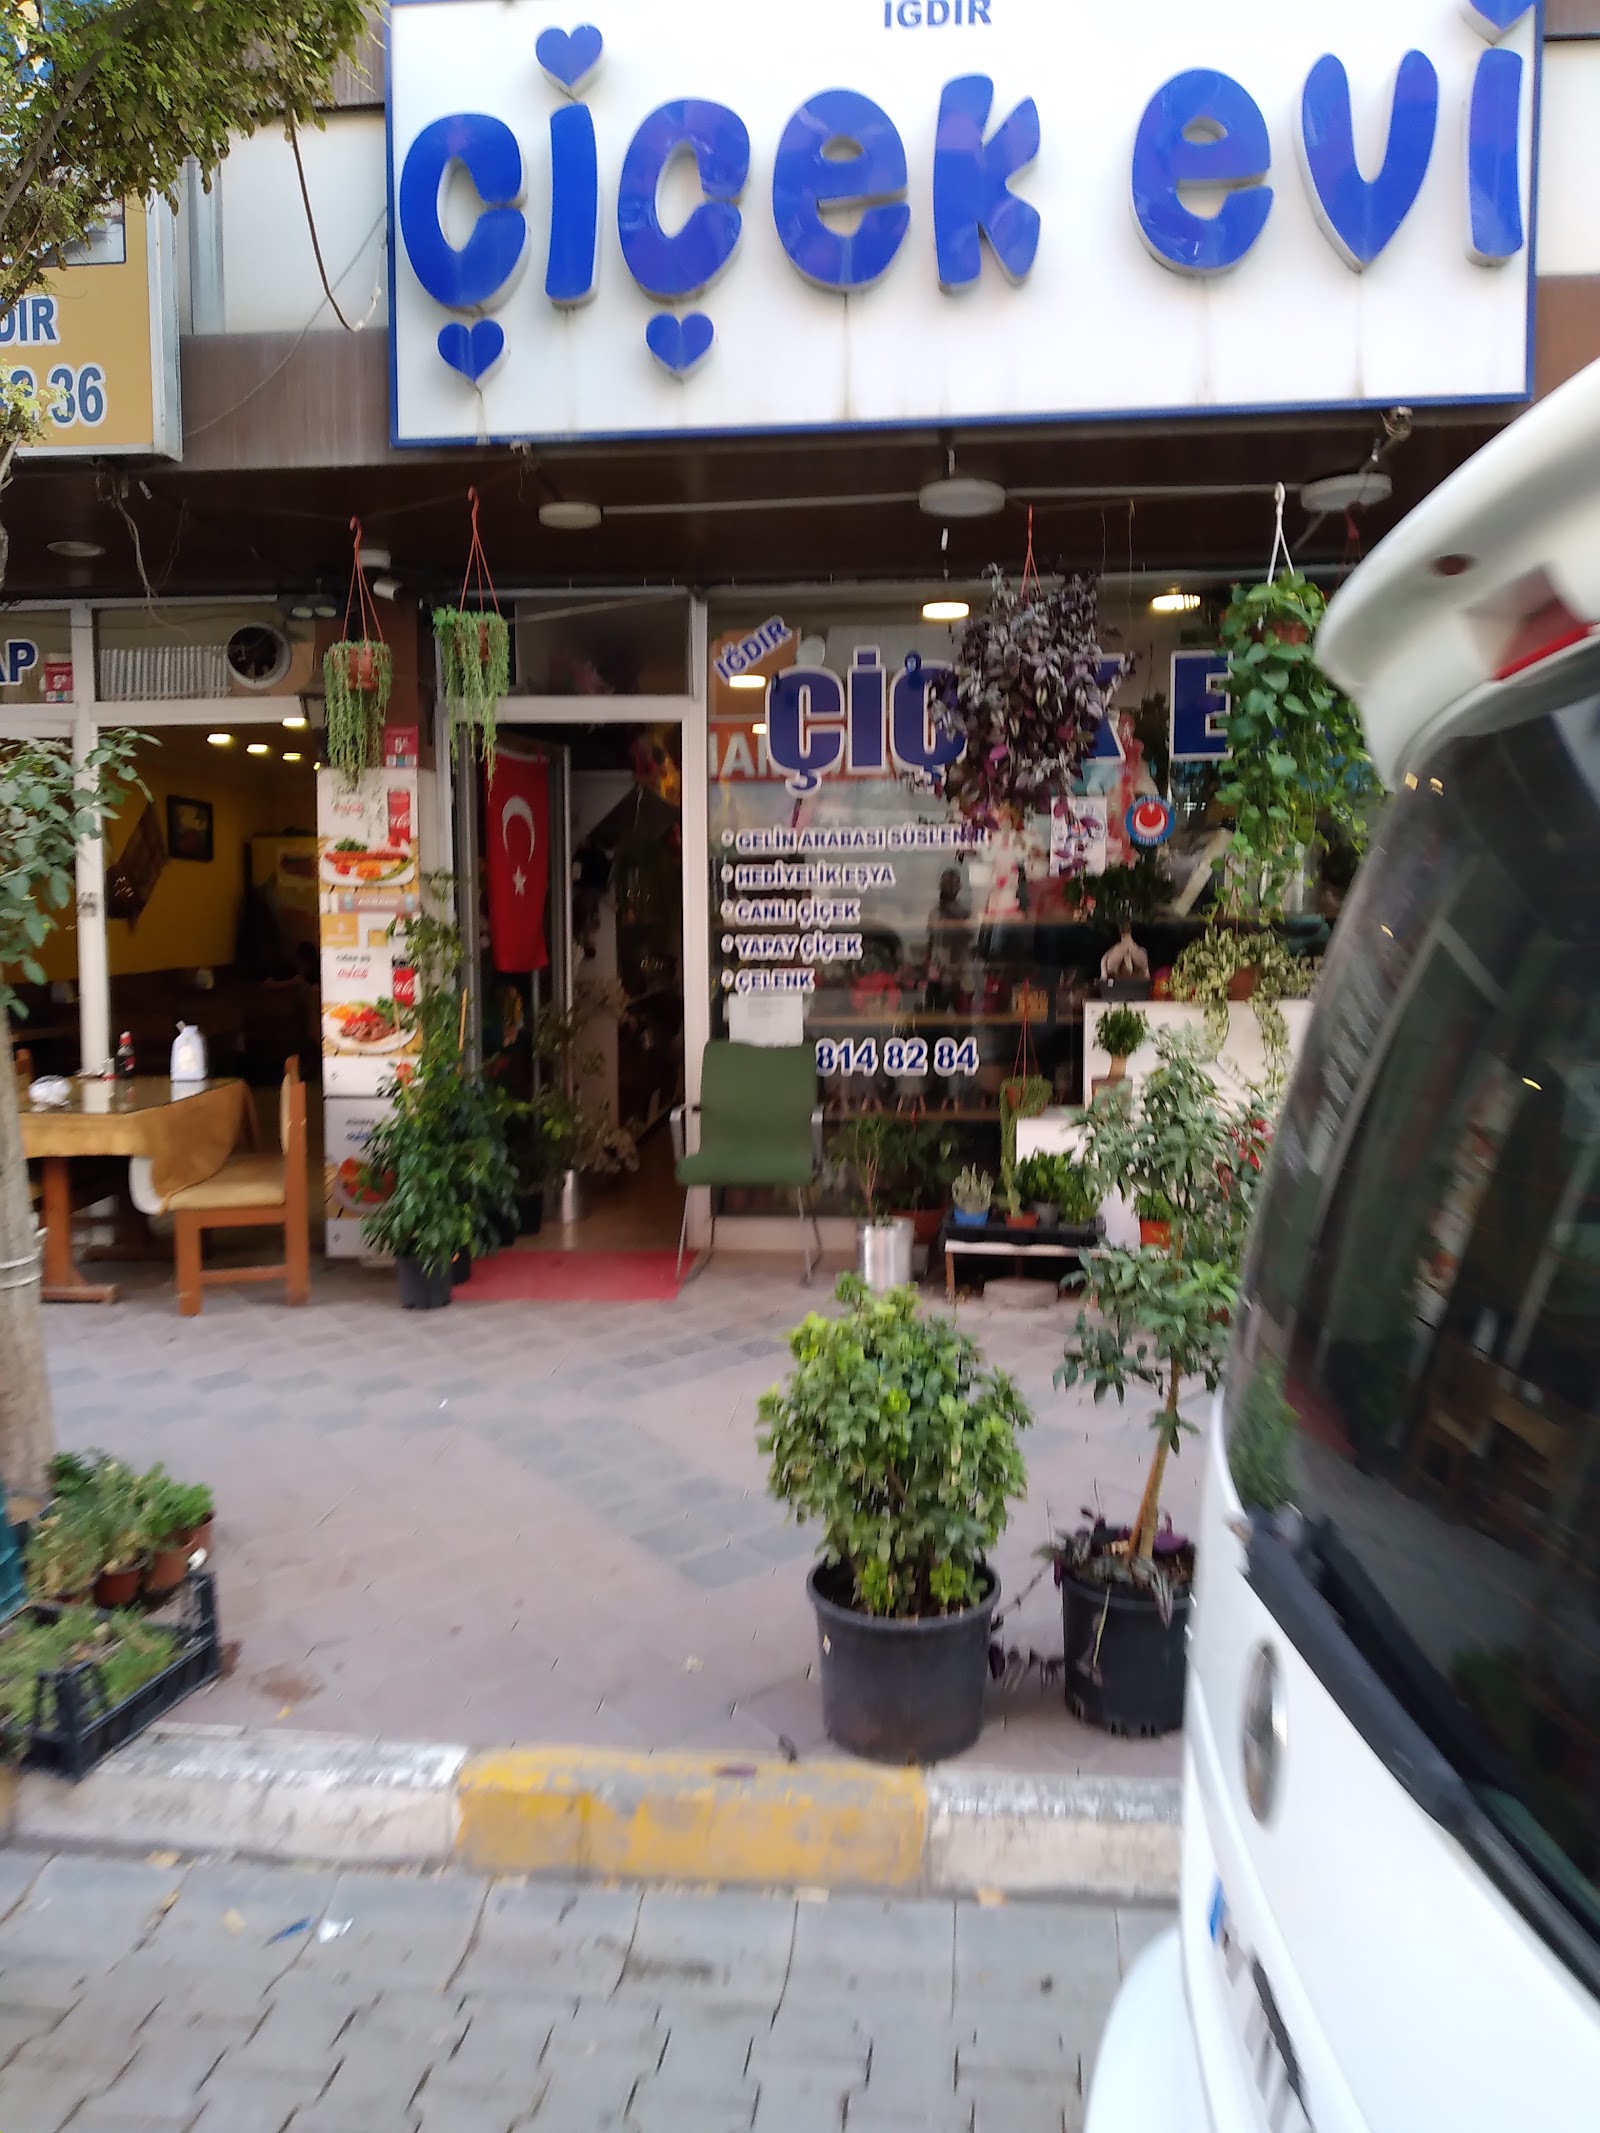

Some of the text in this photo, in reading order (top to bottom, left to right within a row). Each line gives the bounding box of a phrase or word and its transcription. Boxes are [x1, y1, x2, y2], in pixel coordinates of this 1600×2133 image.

[0, 639, 38, 685] P
[737, 825, 797, 853] GELİN
[799, 826, 886, 852] ARABASI
[735, 860, 840, 890] HEDİYELİK
[736, 896, 860, 929] CANLI ÇİÇEK
[736, 930, 862, 964] YAPAY ÇİÇEK
[735, 968, 815, 995] ÇELENK
[816, 1036, 979, 1077] 814 82 84
